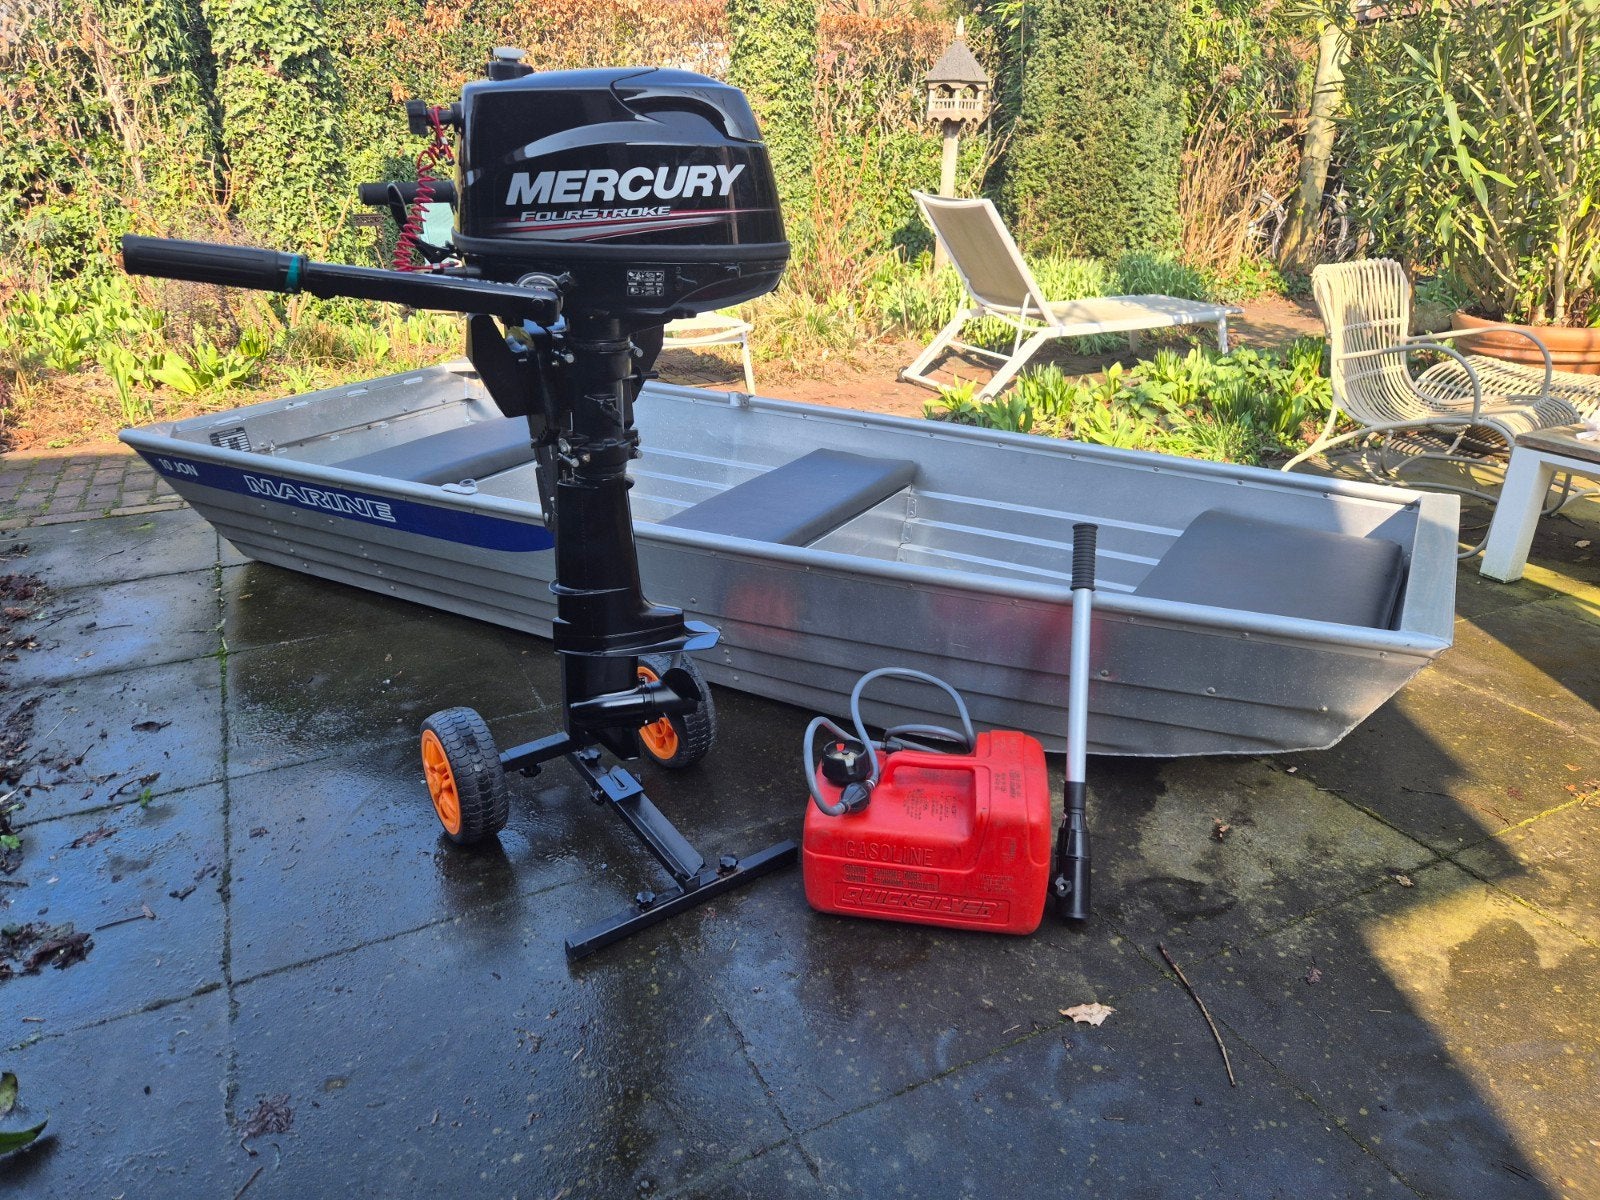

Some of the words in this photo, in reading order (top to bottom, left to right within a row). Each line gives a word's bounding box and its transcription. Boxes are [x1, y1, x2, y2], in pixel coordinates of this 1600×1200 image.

[505, 164, 745, 206] MERCURY
[520, 206, 671, 222] FOURSTROKE
[158, 458, 173, 471] 10
[173, 461, 199, 477] JON
[243, 475, 396, 523] MARINE
[845, 840, 934, 867] GASOLINE
[842, 886, 999, 917] QUICKSILVER
